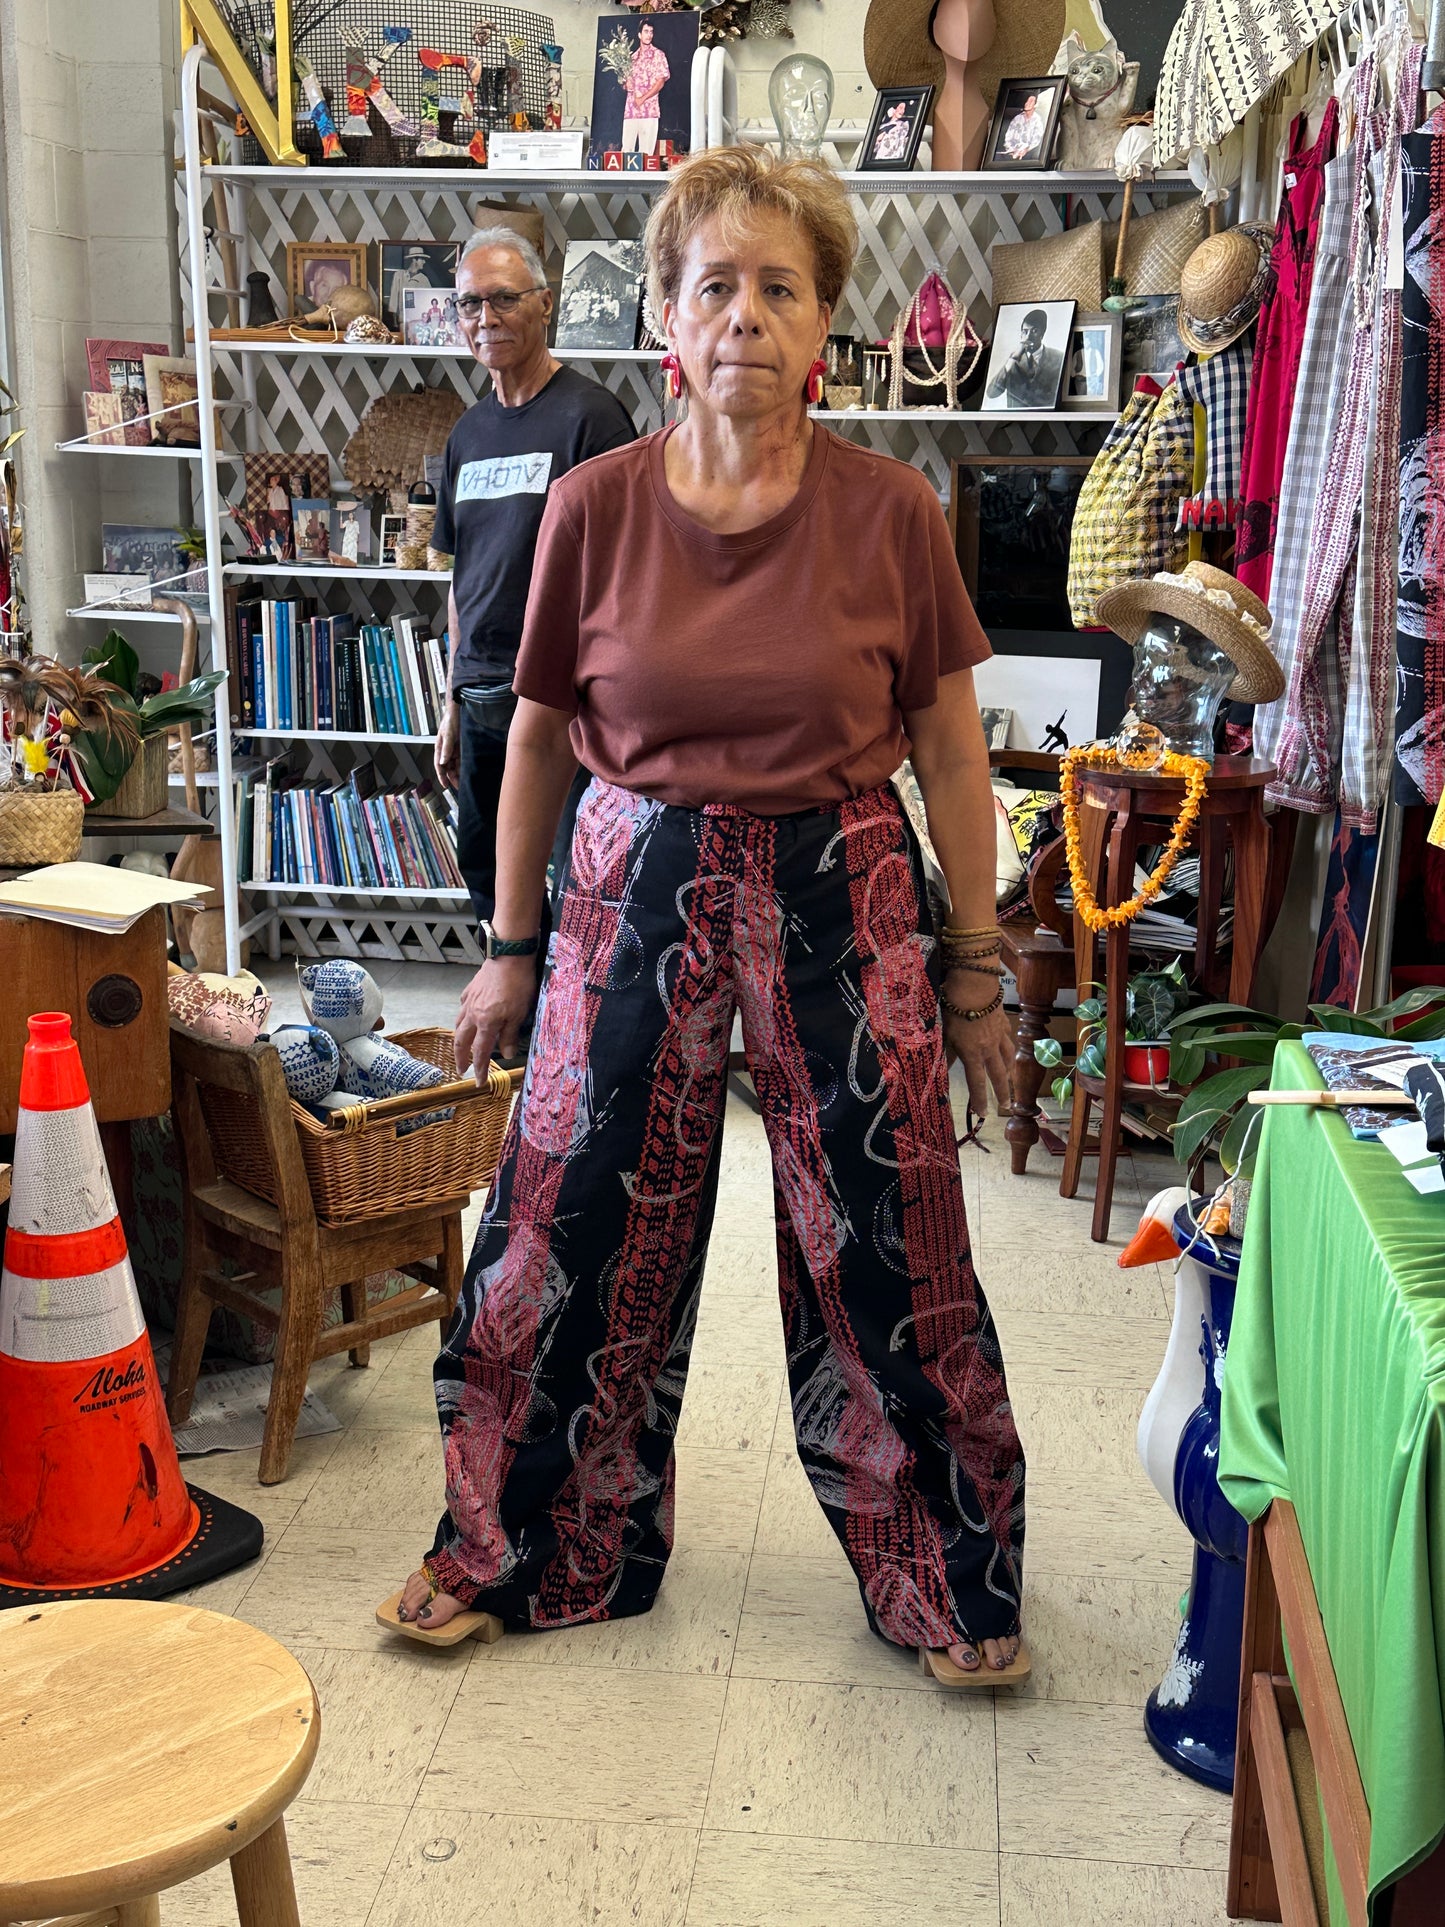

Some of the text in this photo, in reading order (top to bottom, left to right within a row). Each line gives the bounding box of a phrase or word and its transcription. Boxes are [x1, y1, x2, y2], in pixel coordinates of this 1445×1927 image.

[463, 462, 546, 492] ALOHA
[73, 1360, 146, 1403] Aloha
[80, 1386, 146, 1414] ROADWAY SERVICES
